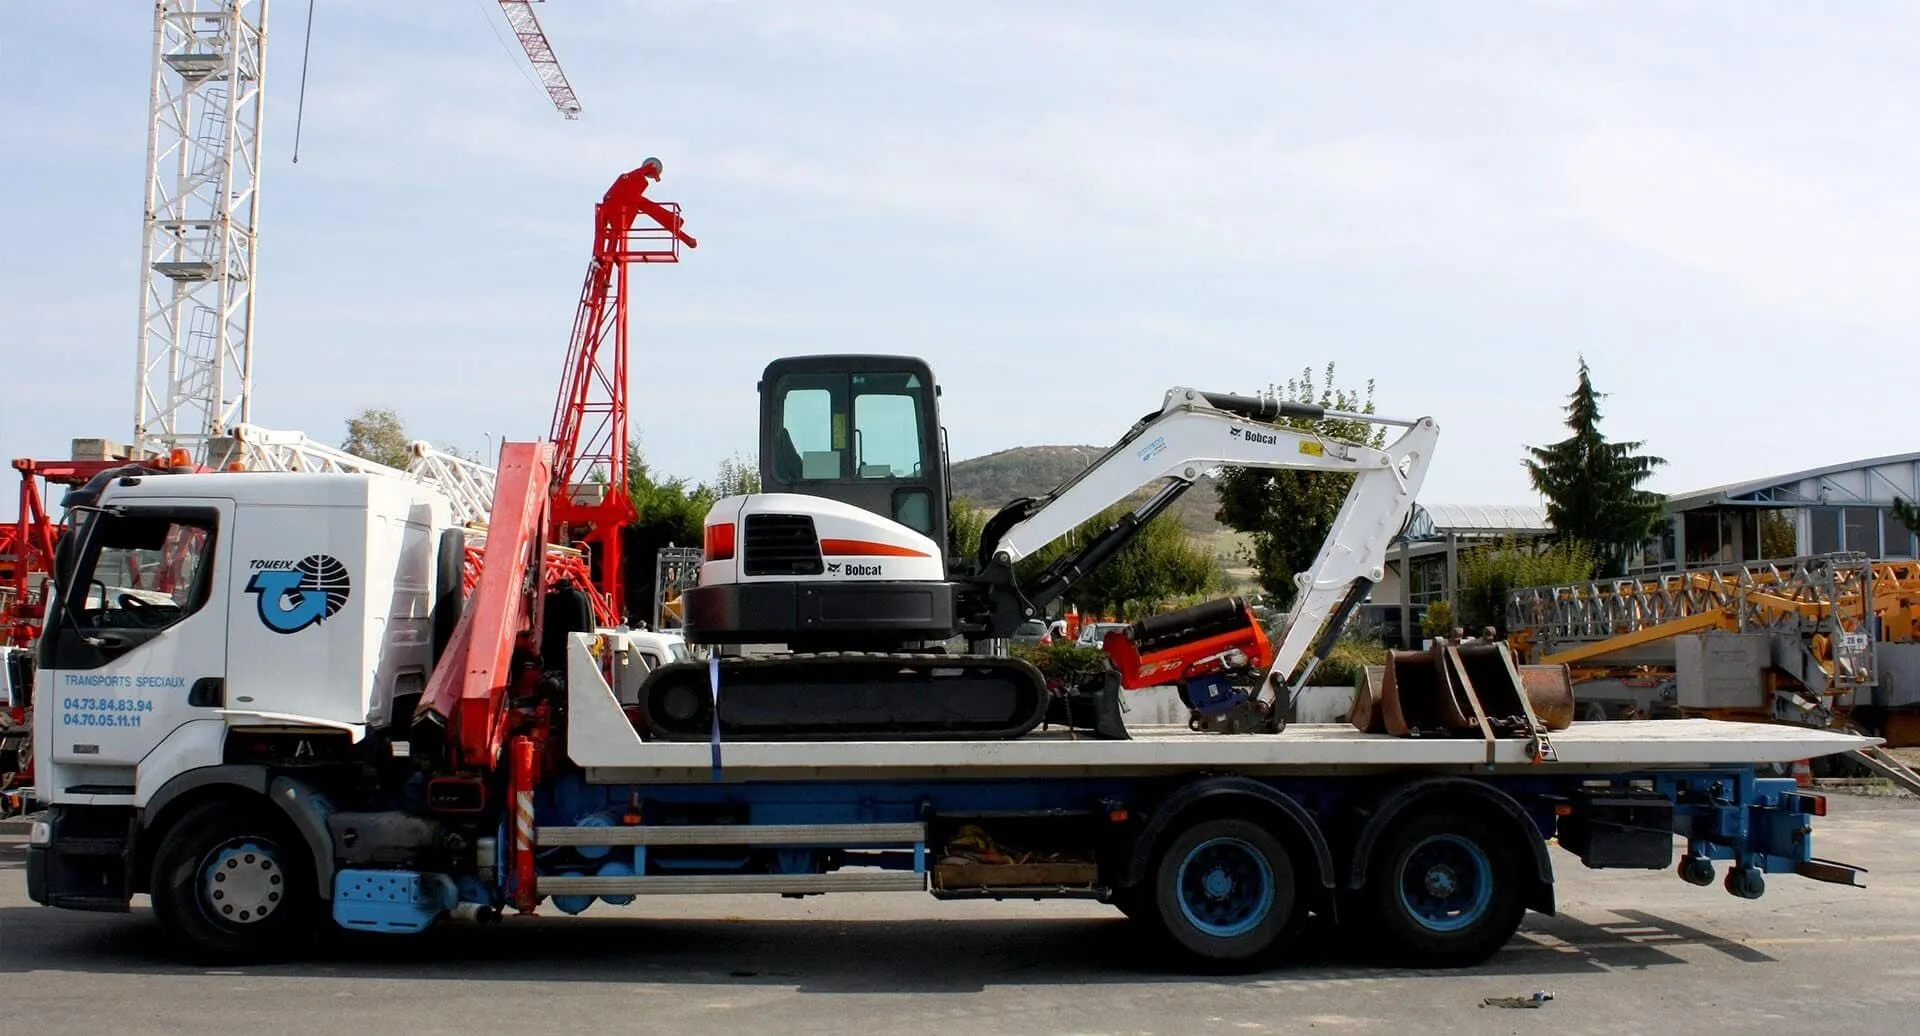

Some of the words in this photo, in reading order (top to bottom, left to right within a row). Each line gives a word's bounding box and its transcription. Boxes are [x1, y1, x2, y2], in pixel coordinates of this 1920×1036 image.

[1245, 430, 1277, 445] Bobcat
[249, 559, 294, 570] TOUEIX
[845, 564, 882, 576] Bobcat
[64, 674, 131, 687] TRANSPORTS
[136, 676, 185, 688] SPECIAUX
[63, 698, 153, 712] 04.73.84.83.94
[63, 714, 141, 728] 04.70.05.11.11
